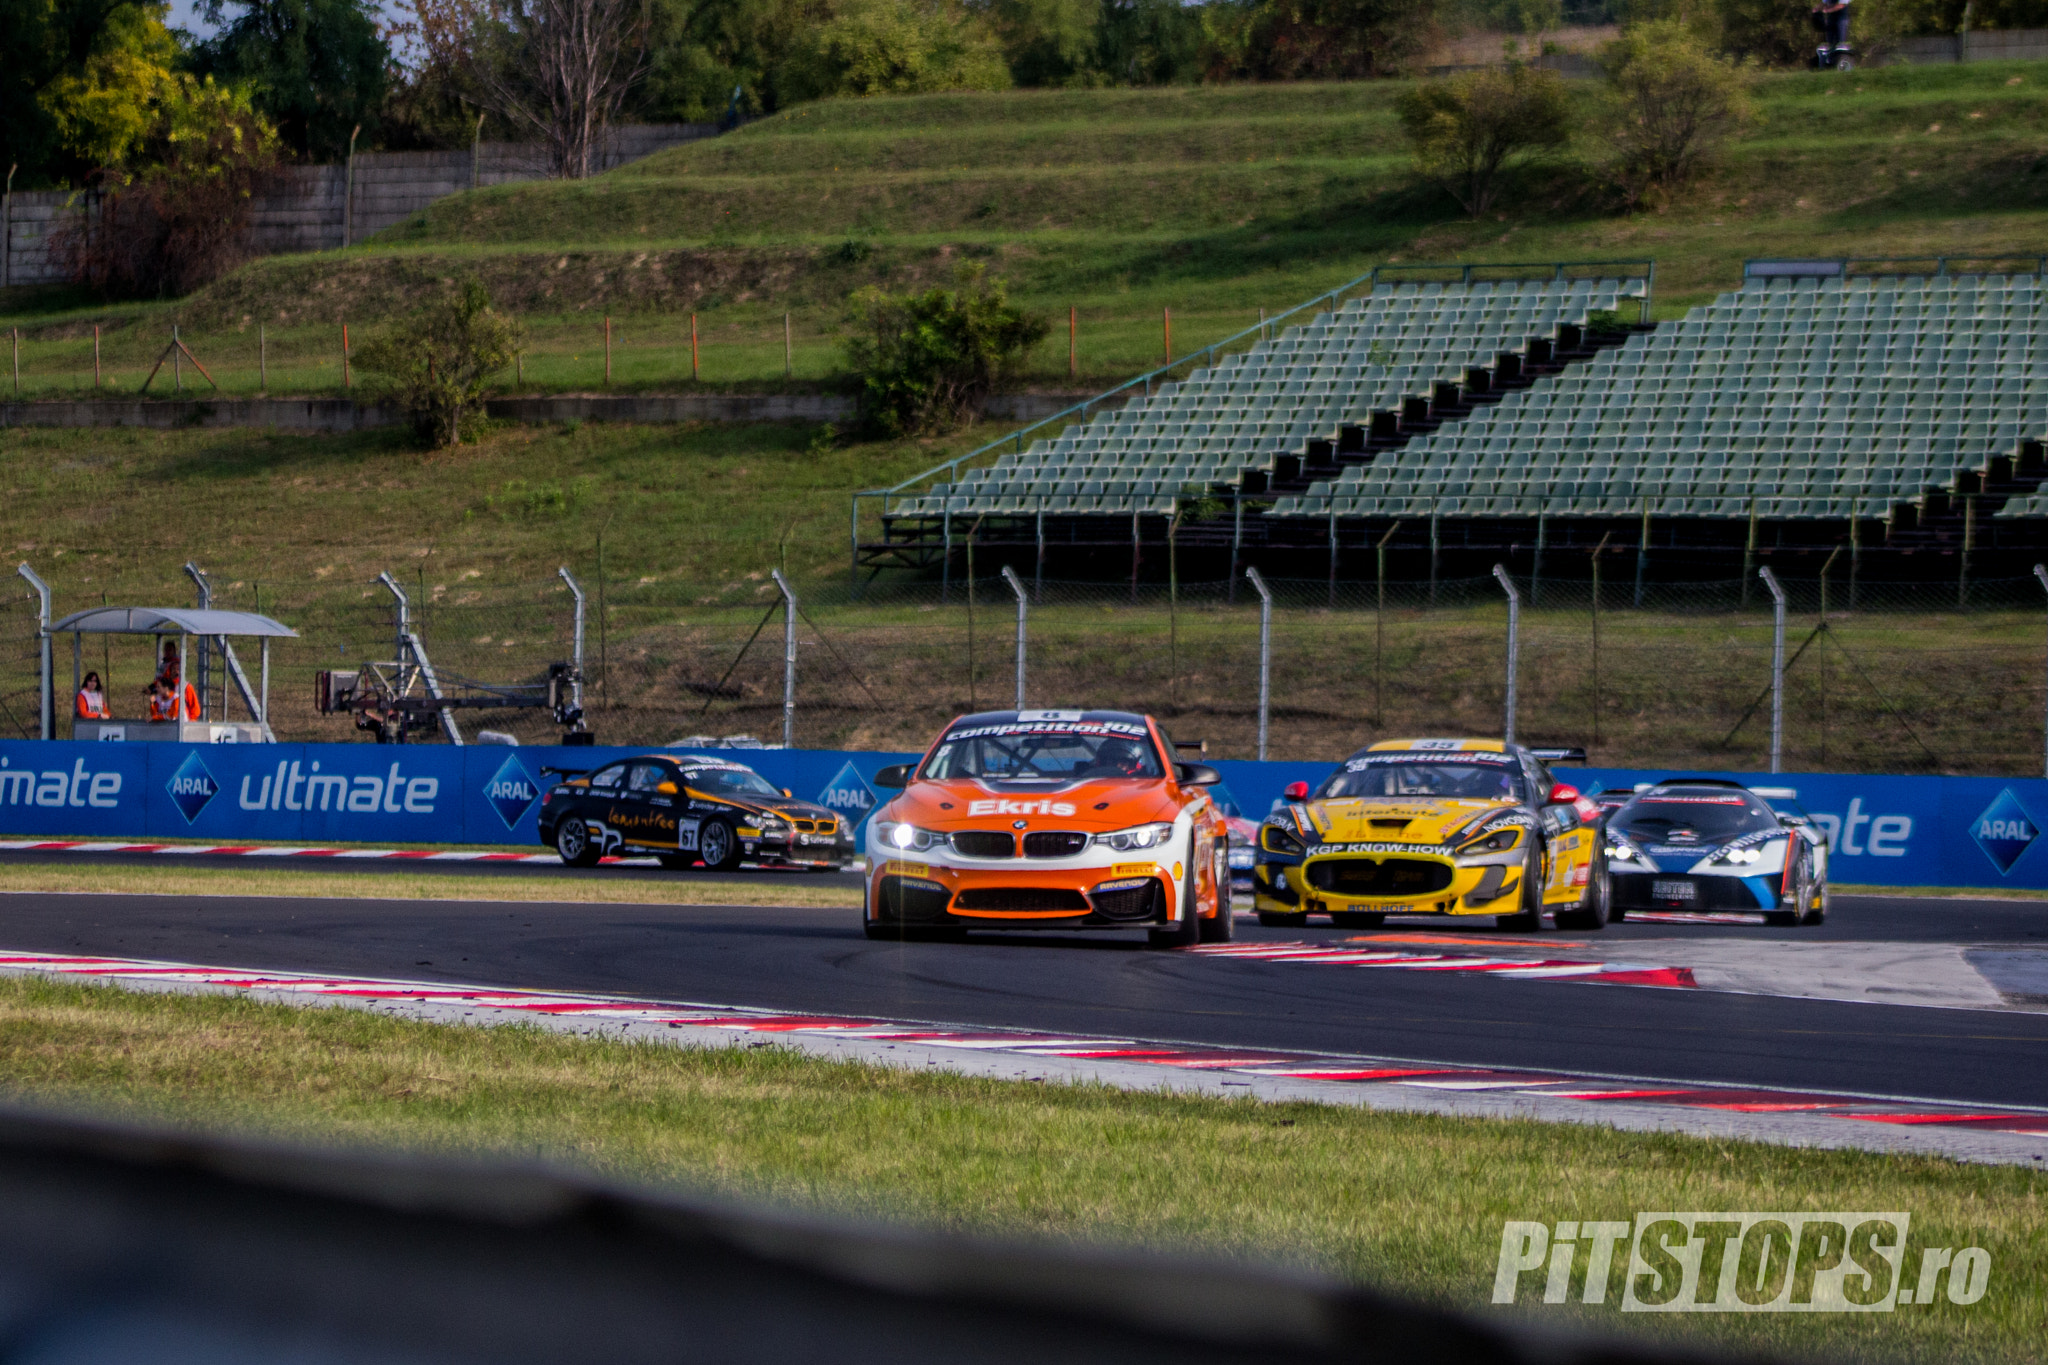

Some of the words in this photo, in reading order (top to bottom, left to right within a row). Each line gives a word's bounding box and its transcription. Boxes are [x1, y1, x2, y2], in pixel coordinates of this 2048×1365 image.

[1421, 741, 1455, 750] 35
[173, 777, 212, 796] ARAL
[239, 760, 439, 814] ultimate
[491, 781, 533, 800] ARAL
[826, 788, 870, 810] ARAL
[967, 798, 1077, 818] Ekris
[681, 829, 696, 847] 67
[1979, 820, 2032, 841] ARAL
[1305, 843, 1344, 858] KGP
[1347, 842, 1453, 857] KNOW-HOW
[1115, 863, 1155, 875] PIRELLI
